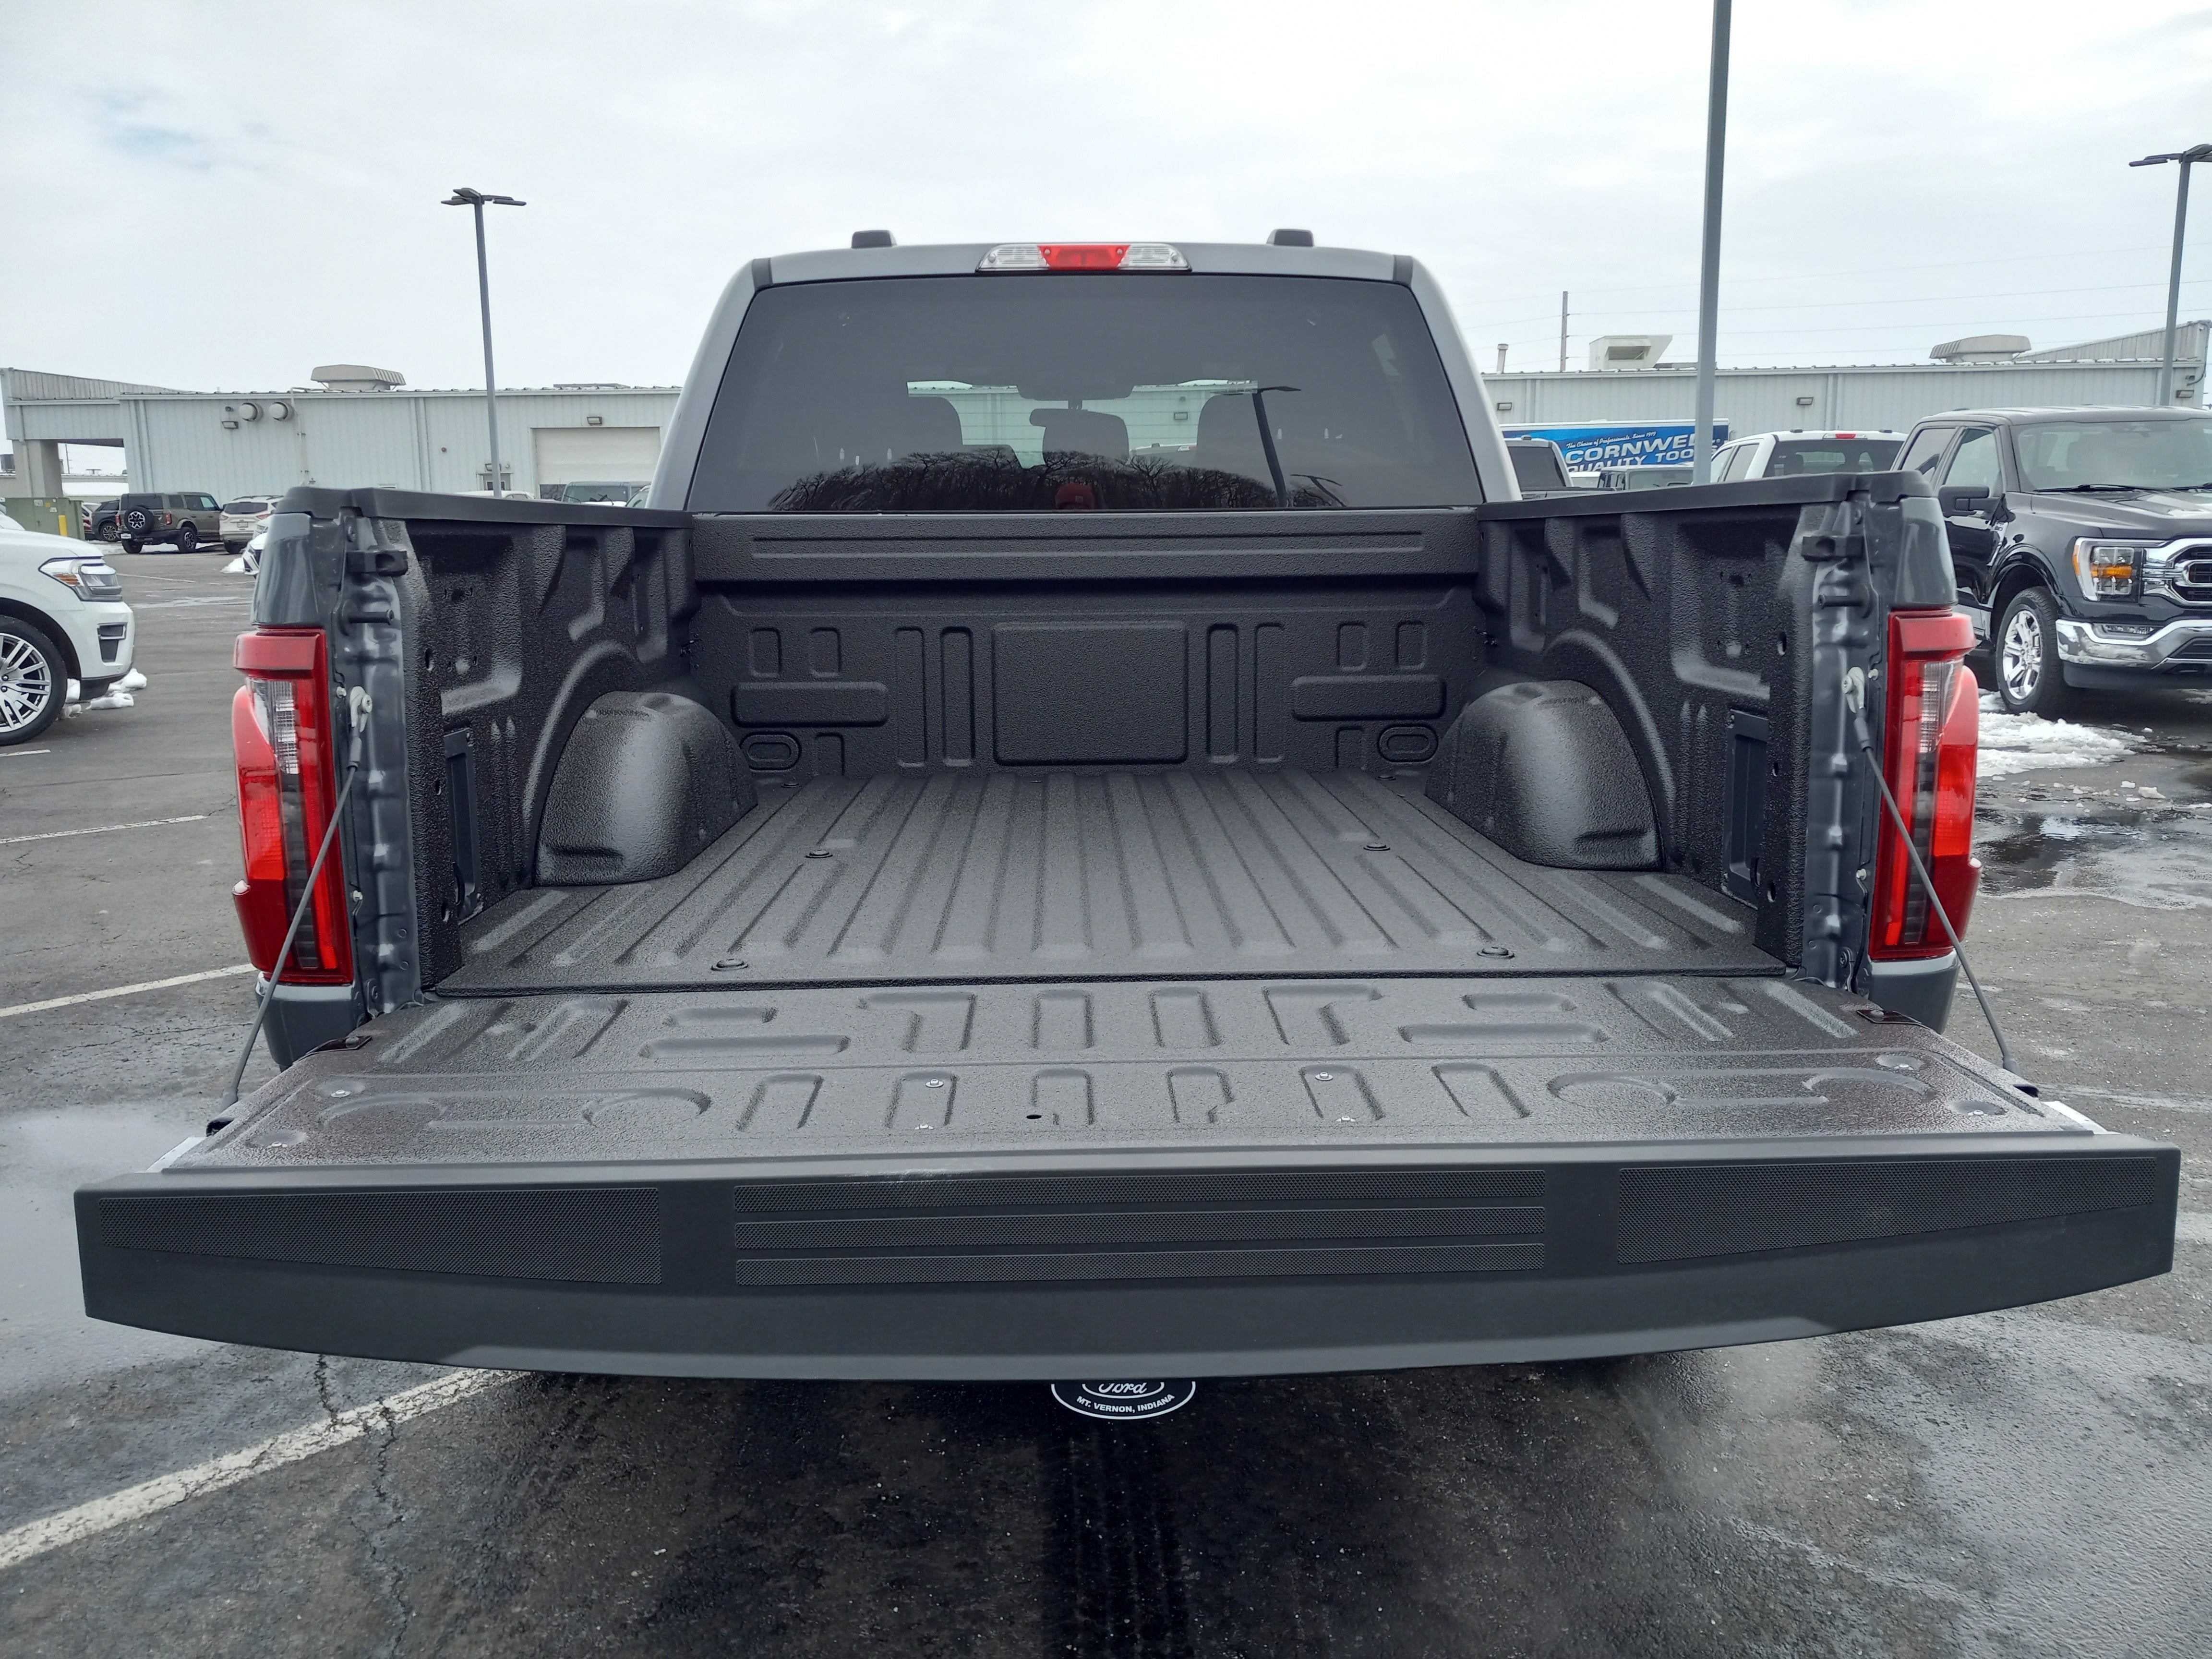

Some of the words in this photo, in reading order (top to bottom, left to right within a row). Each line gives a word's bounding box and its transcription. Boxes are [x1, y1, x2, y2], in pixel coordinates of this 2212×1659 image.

[1565, 433, 1716, 464] CORNWEL
[1655, 445, 1718, 463] TOO
[1076, 1395, 1092, 1407] MT.
[1094, 1402, 1136, 1413] VERNON,
[1137, 1394, 1175, 1411] INDIANA
